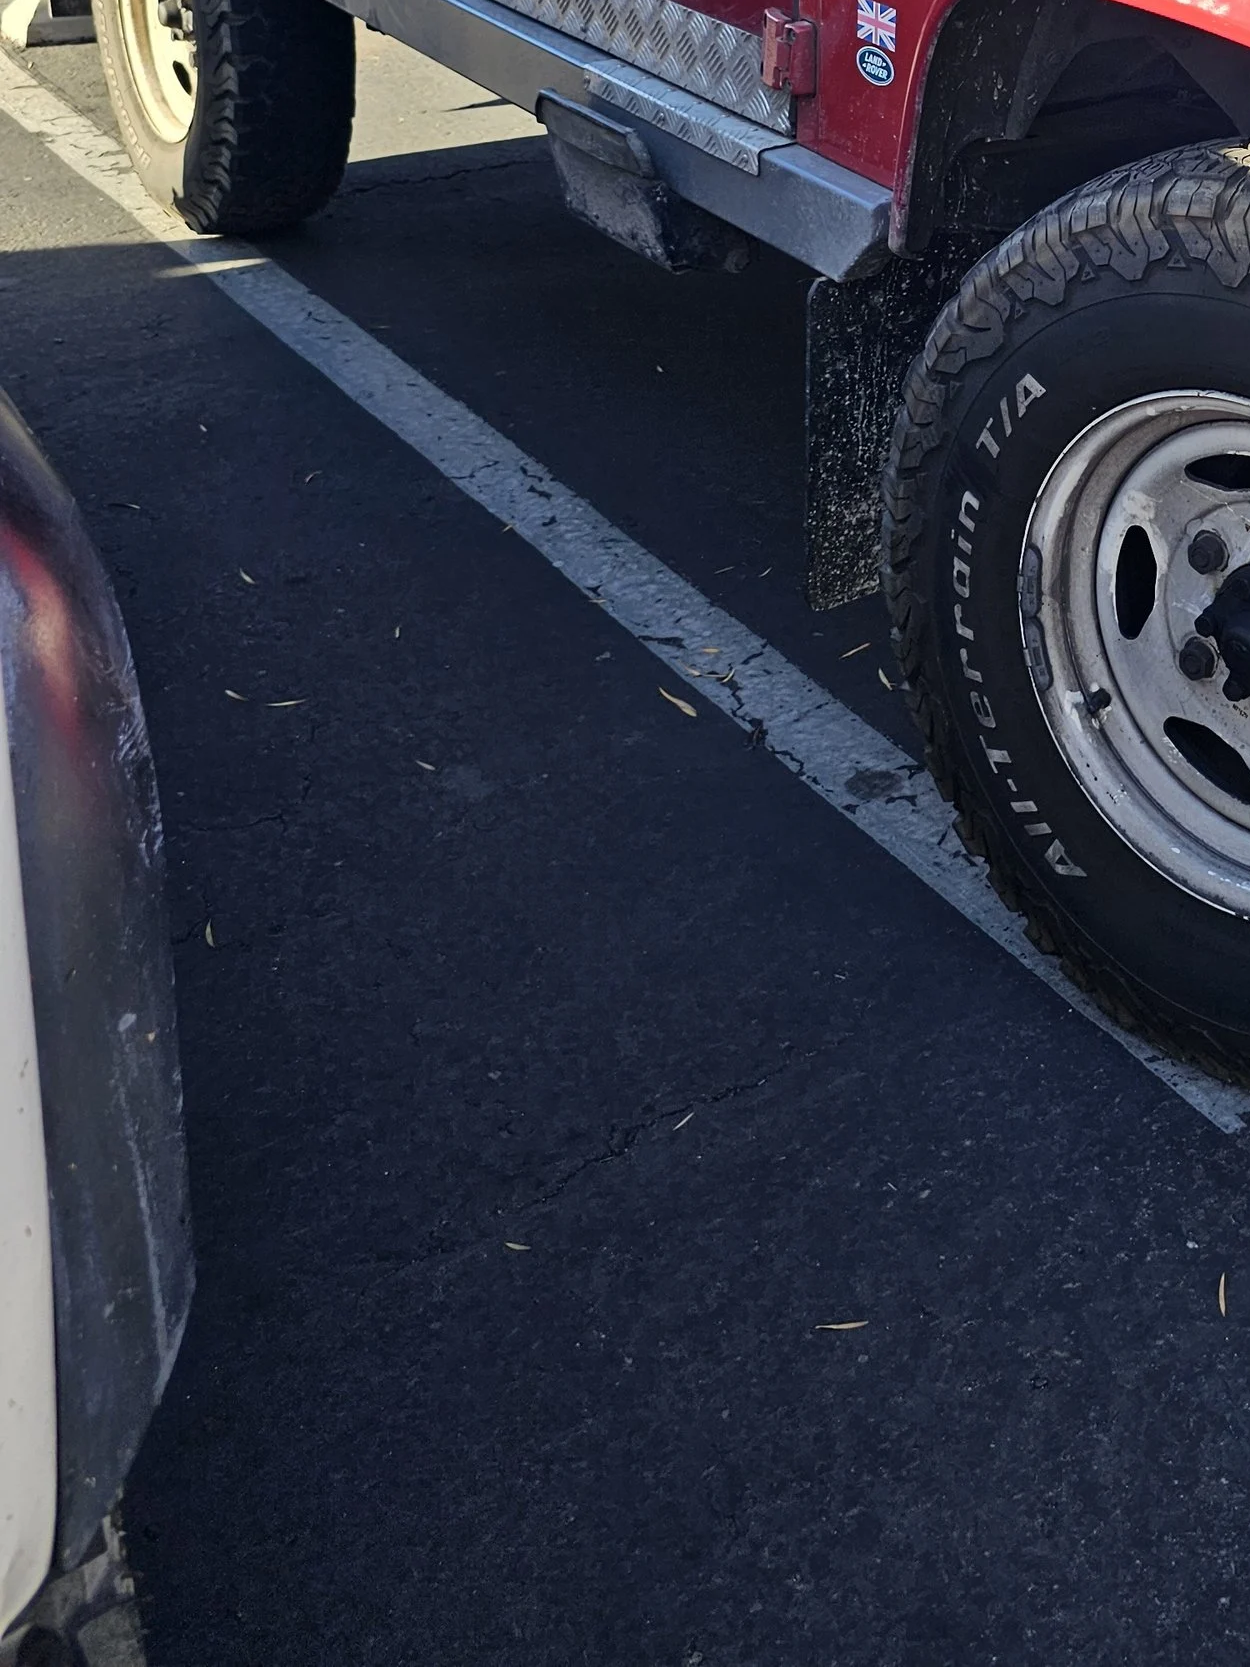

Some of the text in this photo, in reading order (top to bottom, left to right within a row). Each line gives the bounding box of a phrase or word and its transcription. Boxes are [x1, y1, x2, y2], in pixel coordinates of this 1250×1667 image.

[865, 52, 883, 67] LAND
[866, 63, 888, 80] ROVER
[951, 373, 1087, 877] All-Terrain T/A
